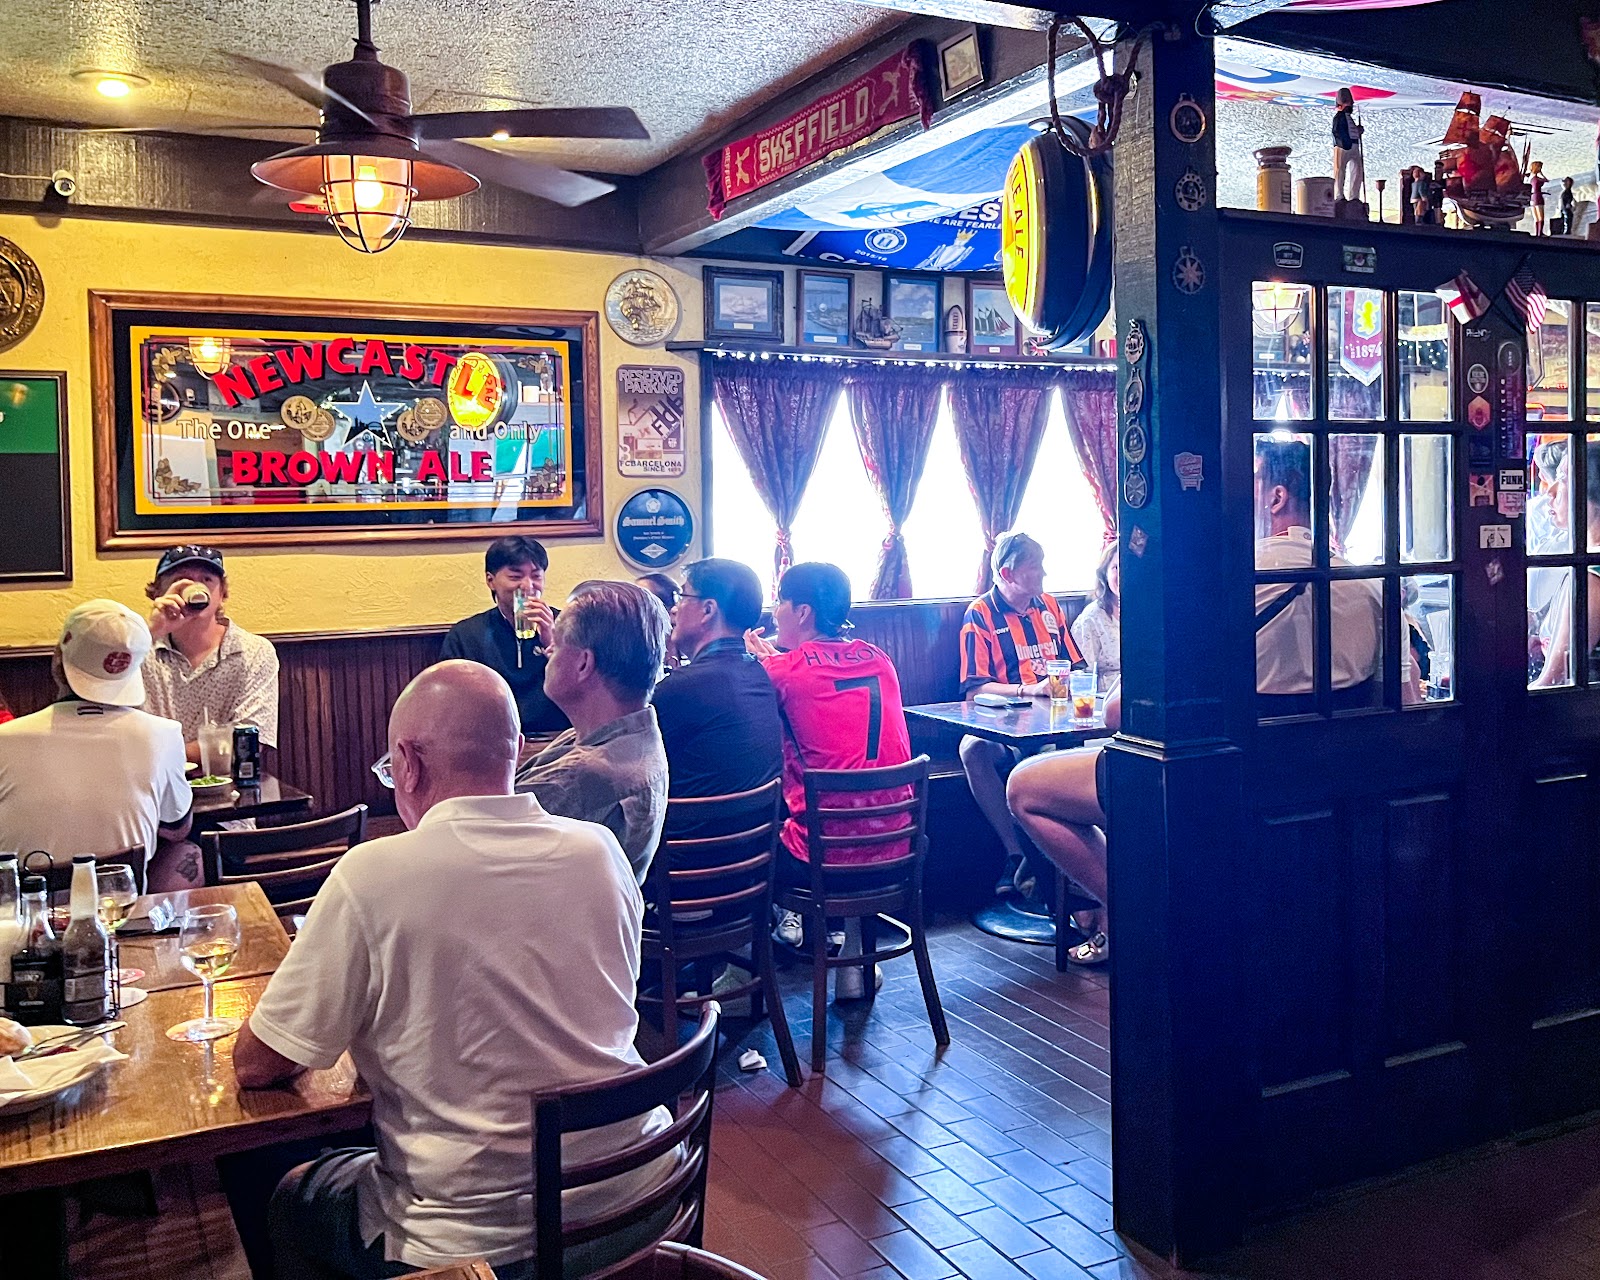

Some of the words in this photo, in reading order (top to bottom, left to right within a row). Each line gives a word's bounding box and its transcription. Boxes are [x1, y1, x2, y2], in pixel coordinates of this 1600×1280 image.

[759, 86, 870, 175] SHEFFIELD
[944, 201, 1001, 223] ES
[942, 218, 964, 228] ARE
[1355, 341, 1383, 359] 1874
[618, 369, 683, 383] RESERVED
[624, 380, 679, 395] PARKING
[176, 417, 223, 441] The
[227, 419, 272, 441] One
[449, 423, 488, 442] and
[493, 420, 543, 444] Only
[231, 450, 396, 485] BROWN
[415, 449, 494, 483] ALE
[1501, 475, 1524, 486] FUNK
[833, 675, 881, 761] 7
